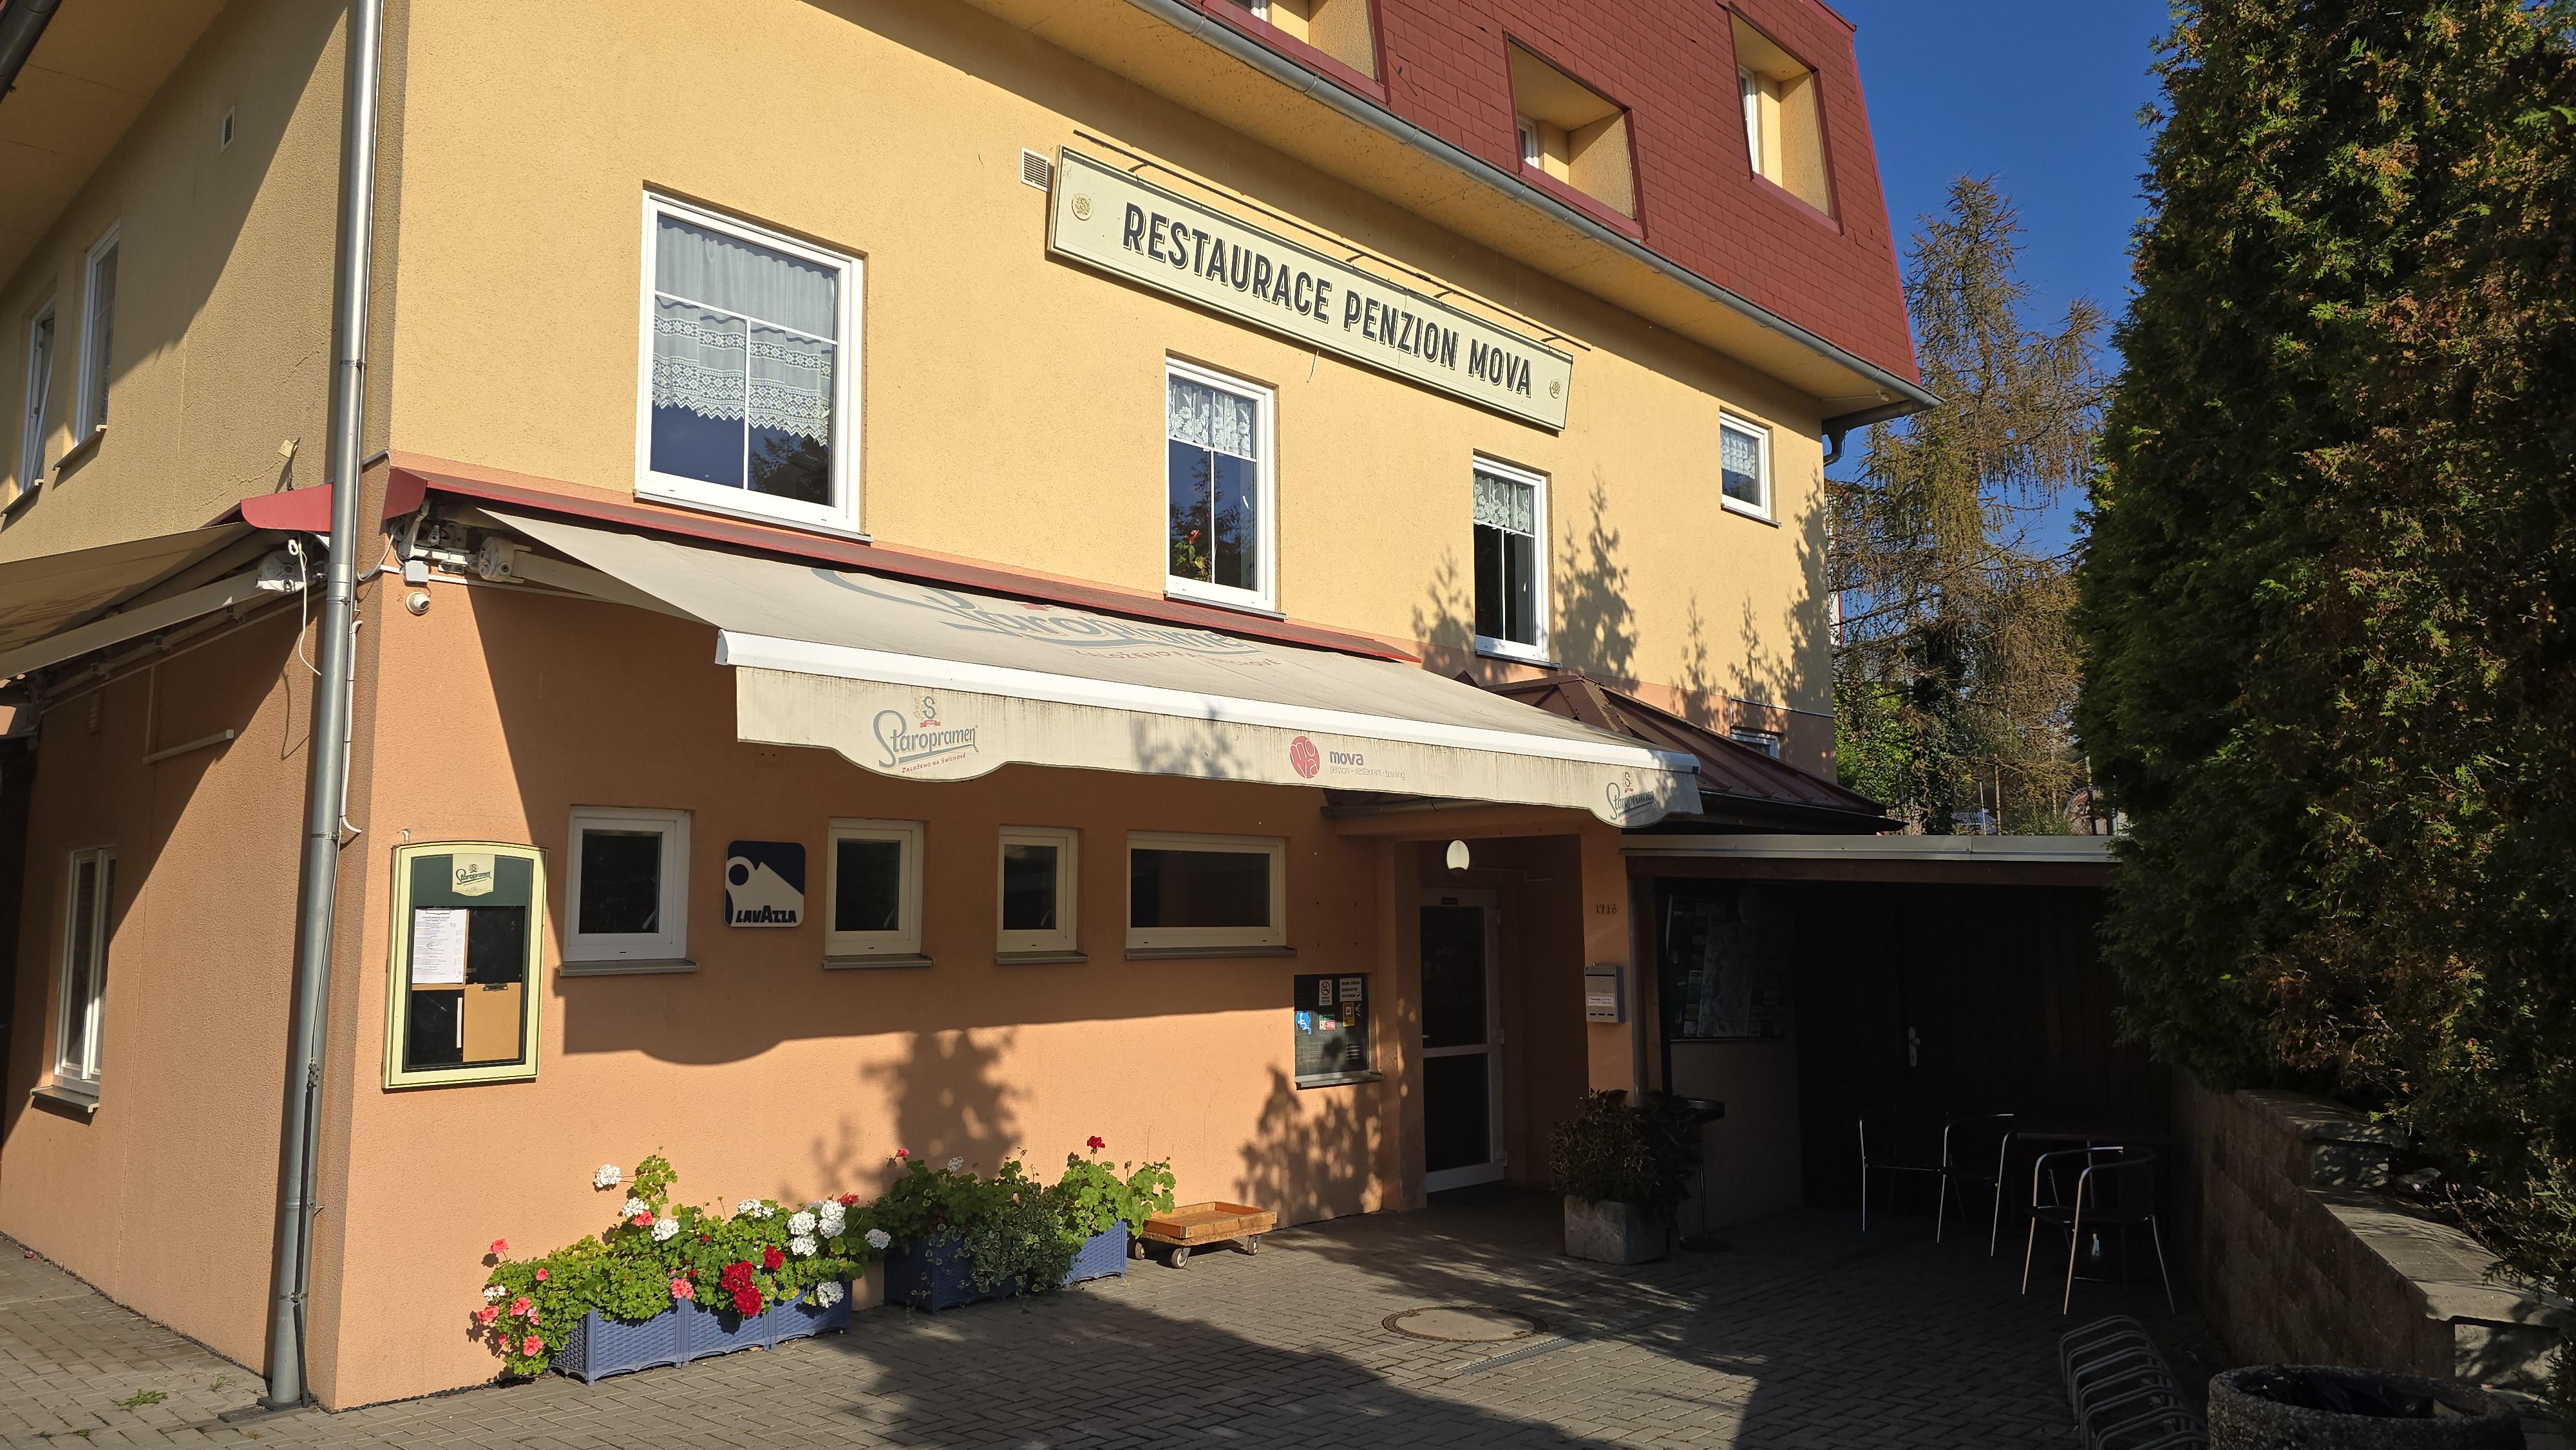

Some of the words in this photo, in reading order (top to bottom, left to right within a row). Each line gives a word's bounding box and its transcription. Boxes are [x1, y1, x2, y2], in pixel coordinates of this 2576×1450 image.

[1123, 202, 1332, 324] RESTAURACE
[1343, 289, 1459, 370] PENZION
[1468, 339, 1532, 398] MOVA
[873, 710, 979, 768] Staropramen
[1329, 751, 1364, 766] mova
[1606, 782, 1656, 820] Staropramen
[735, 905, 797, 923] LAVAZZA
